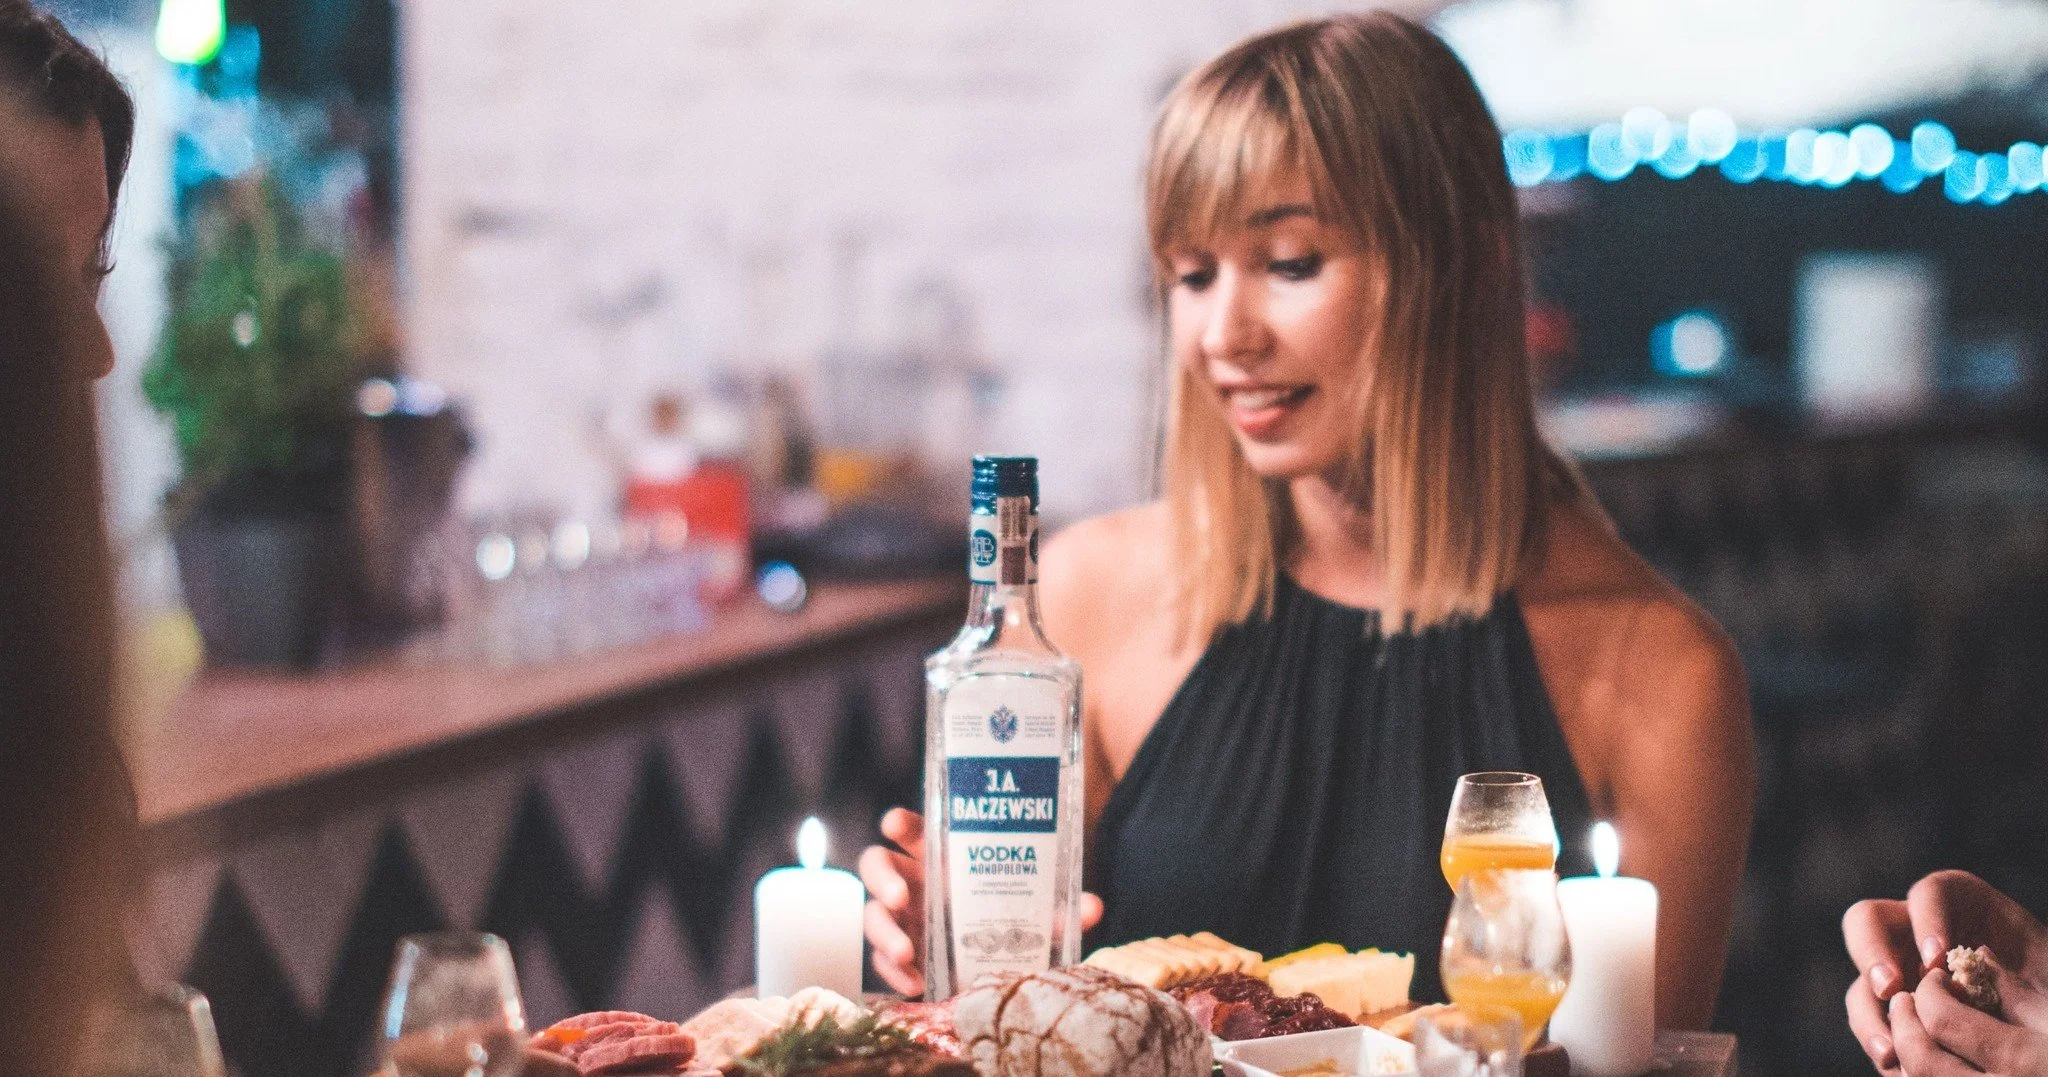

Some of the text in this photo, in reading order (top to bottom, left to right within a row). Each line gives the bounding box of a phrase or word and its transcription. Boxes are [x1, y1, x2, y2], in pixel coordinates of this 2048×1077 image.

[986, 768, 1020, 792] J.A.
[953, 797, 1053, 820] BACZEWSKI
[968, 846, 1036, 862] VODKA
[969, 863, 1037, 875] MONOPOLOWA
